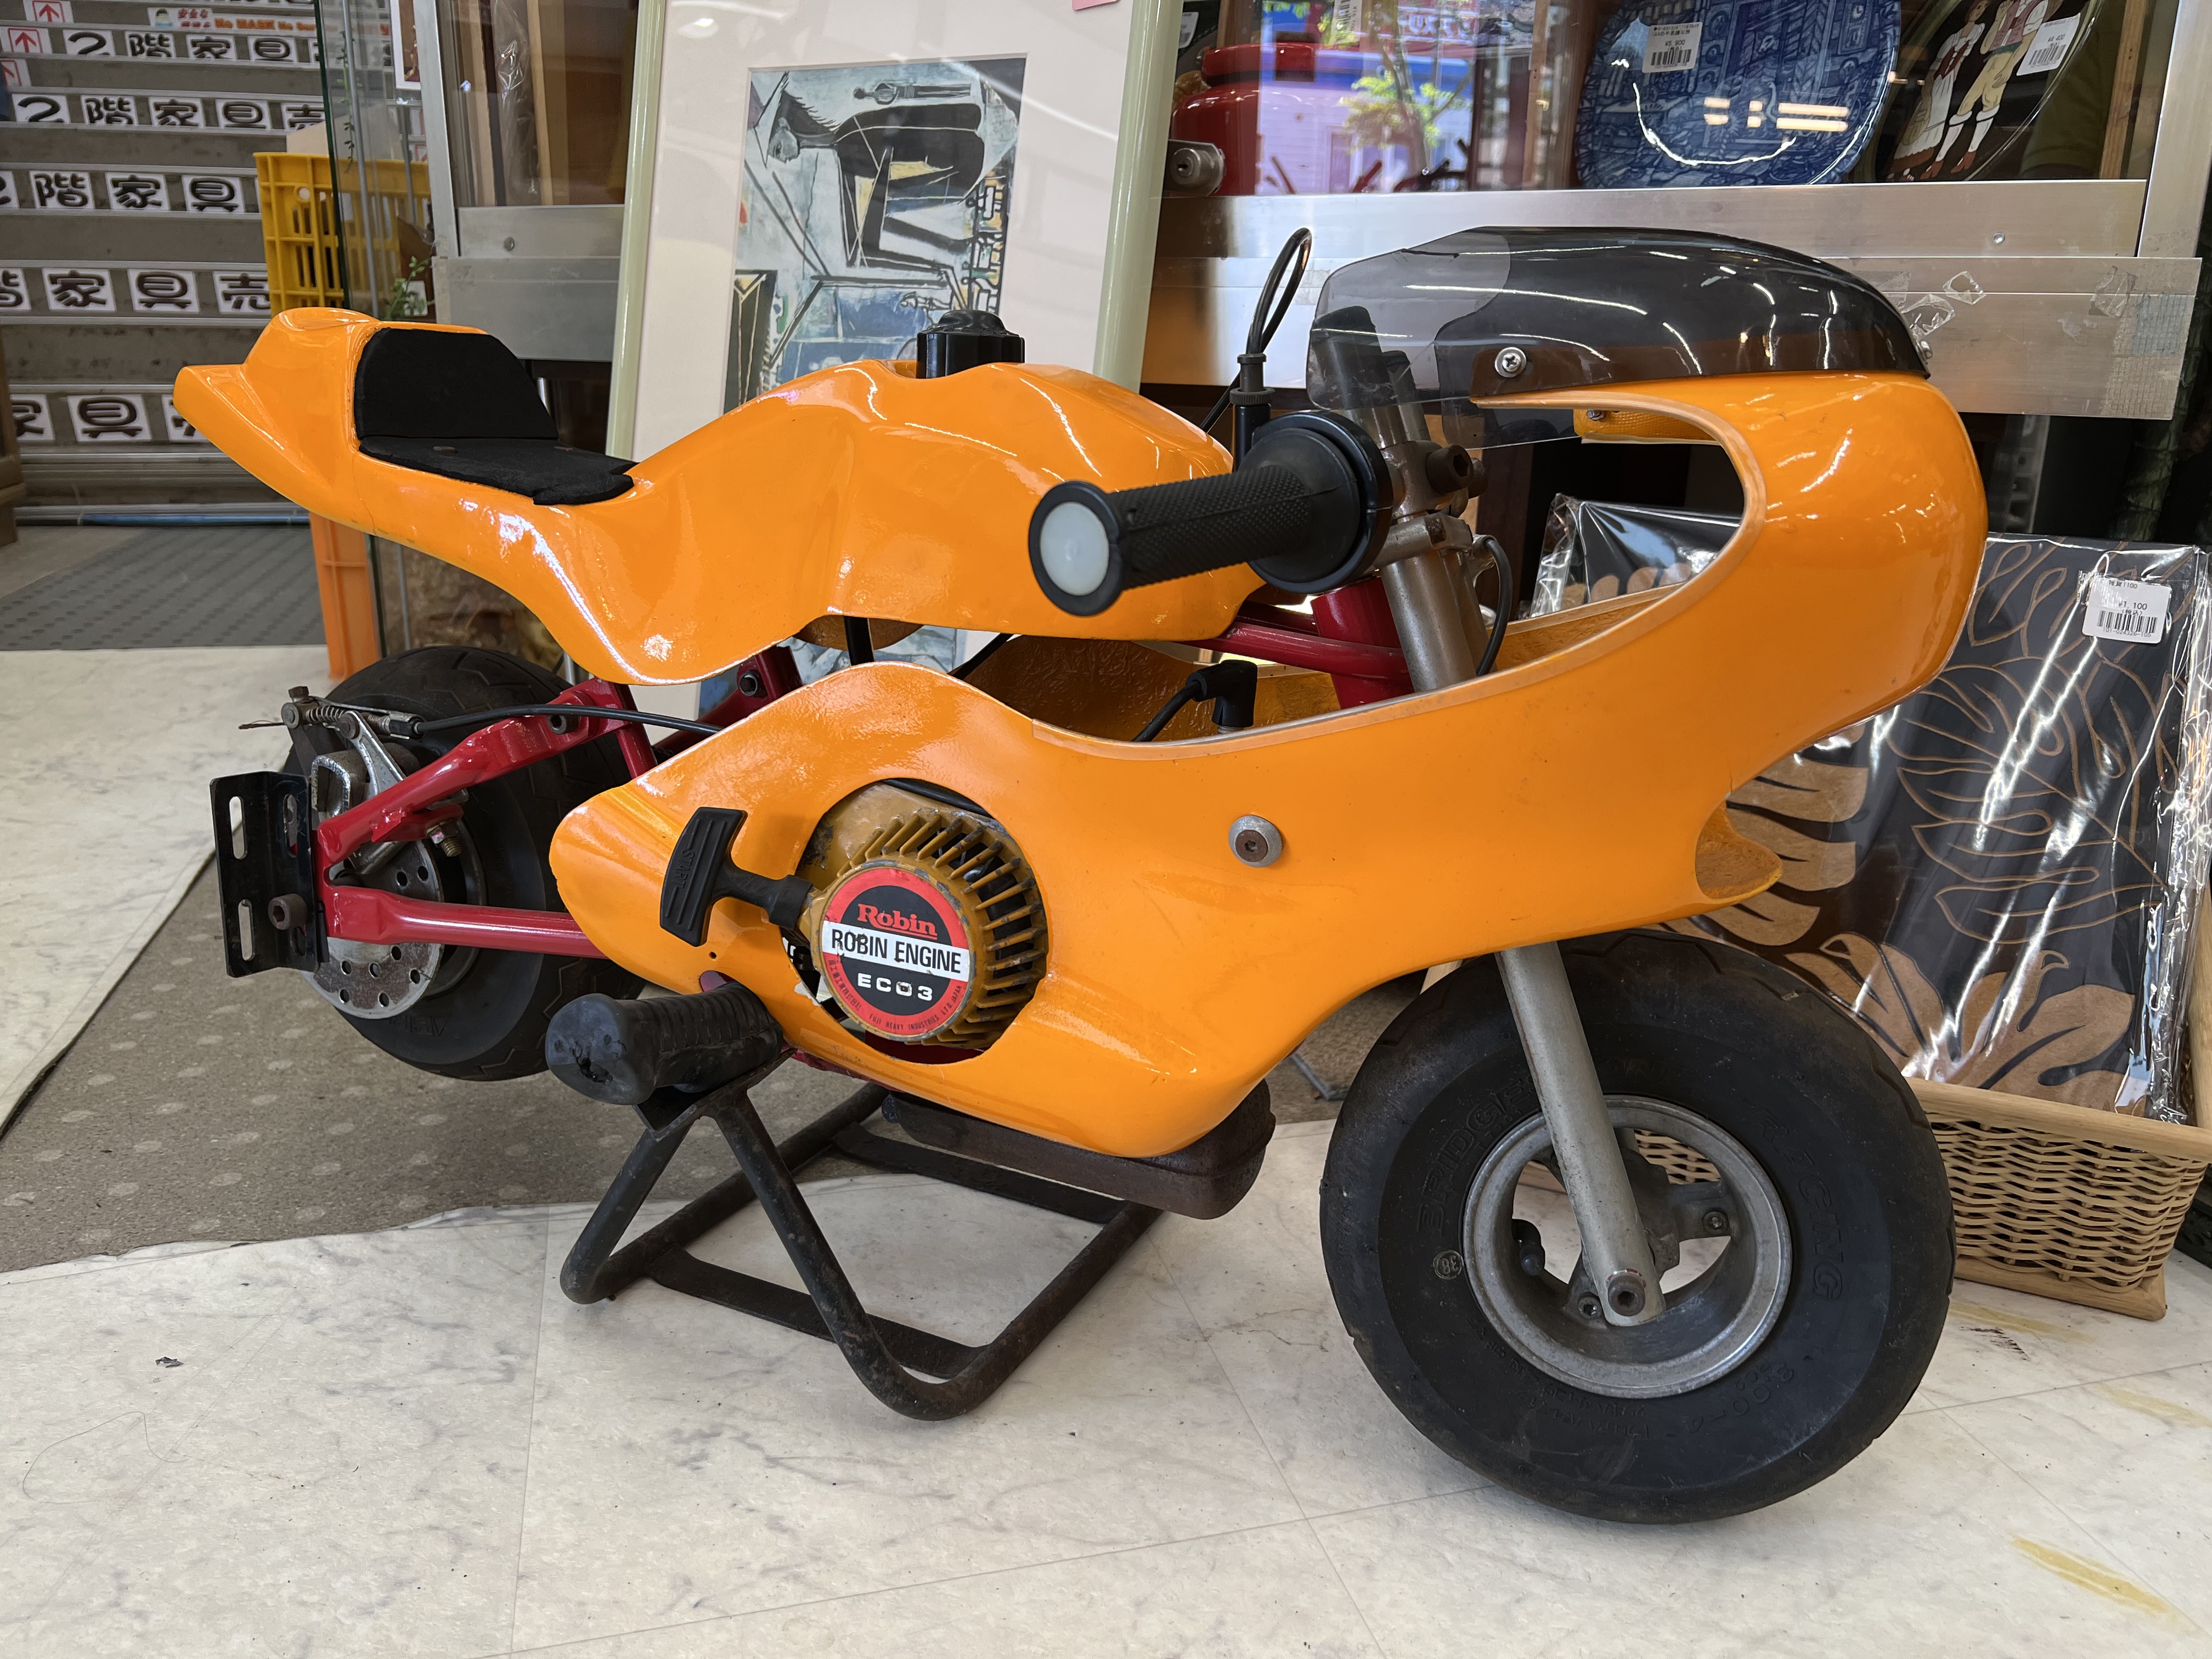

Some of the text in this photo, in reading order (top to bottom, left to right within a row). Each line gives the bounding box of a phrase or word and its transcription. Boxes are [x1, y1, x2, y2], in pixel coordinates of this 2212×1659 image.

[0, 173, 239, 211] 階家具
[672, 849, 695, 889] START
[857, 903, 938, 940] Robin
[831, 928, 962, 974] ROBIN ENGINE
[869, 1014, 882, 1025] FUJI
[885, 1021, 904, 1030] HEAVY
[908, 1014, 940, 1030] INDUSTRIES
[951, 984, 962, 1003] JAPAN
